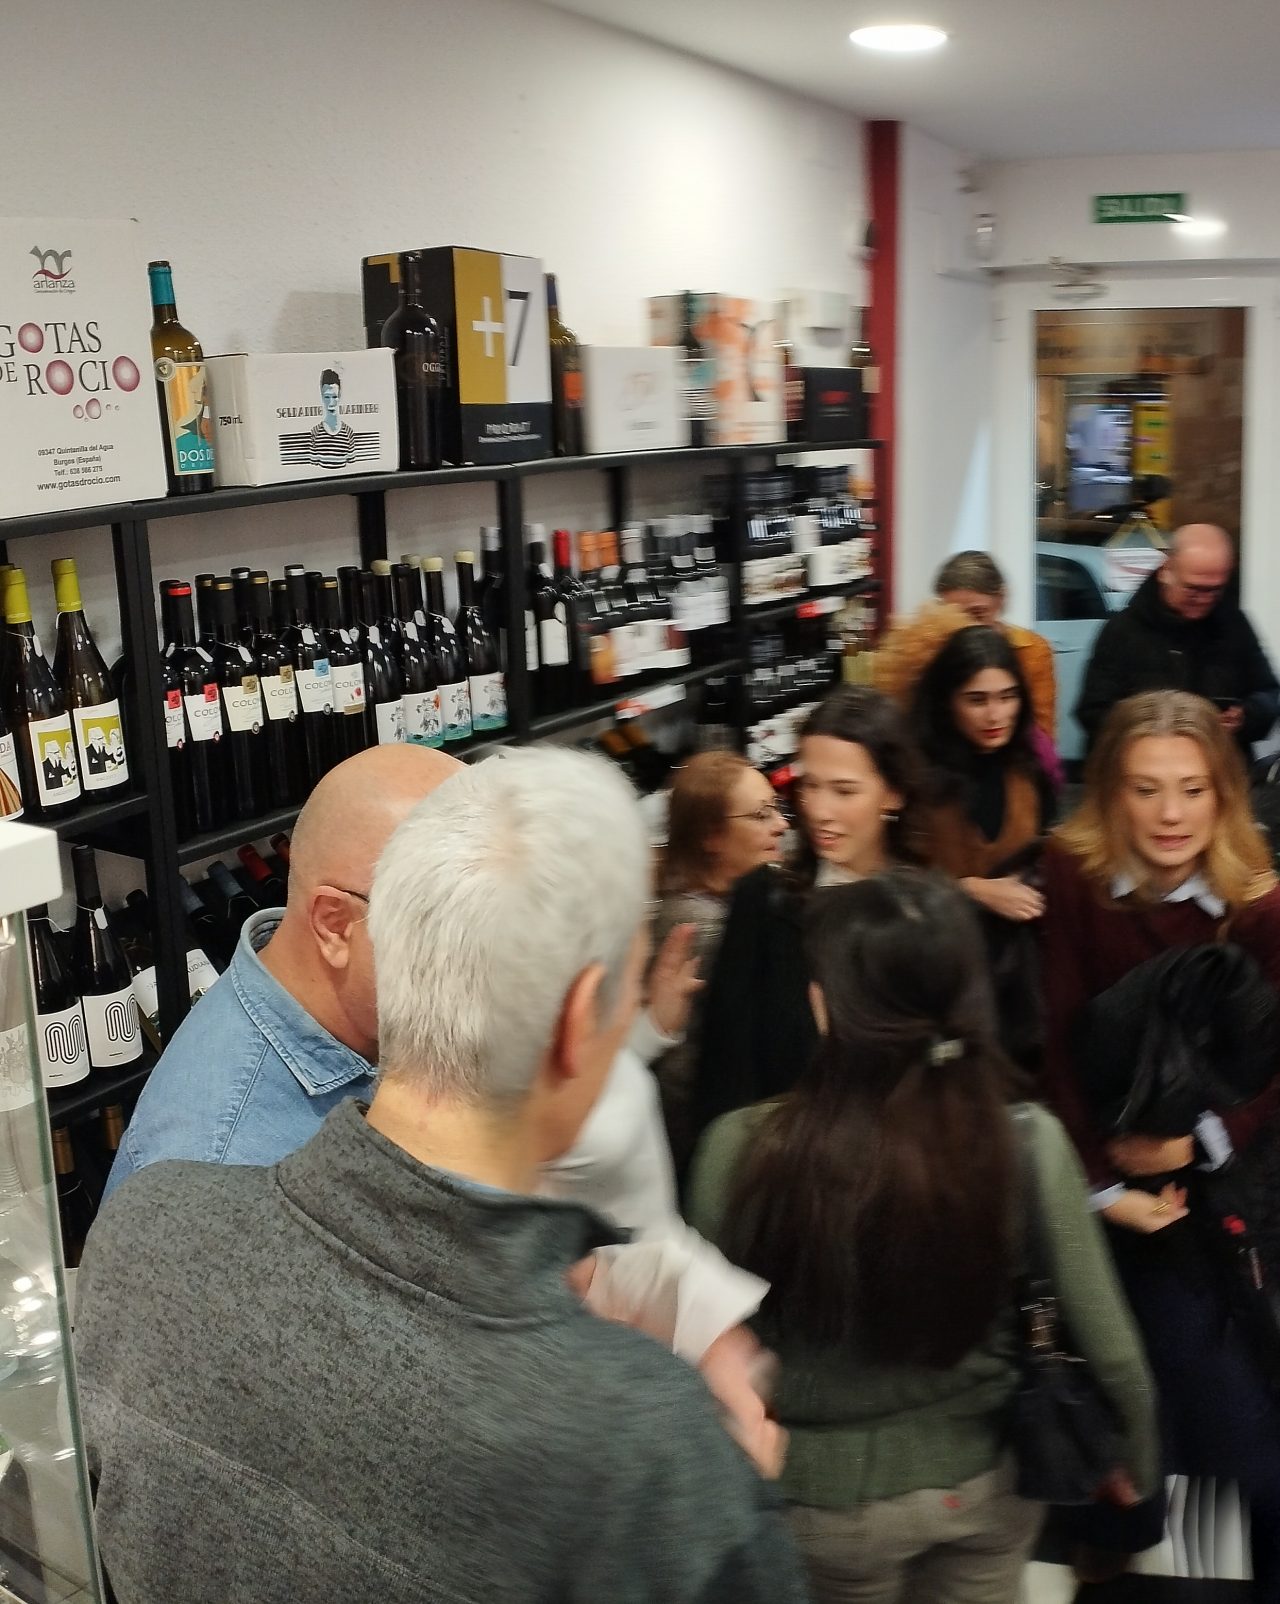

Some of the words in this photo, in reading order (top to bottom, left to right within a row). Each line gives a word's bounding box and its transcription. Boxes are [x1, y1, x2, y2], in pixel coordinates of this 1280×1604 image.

[33, 275, 75, 289] arlanza
[0, 321, 102, 358] GOTAS
[0, 361, 18, 383] E
[22, 355, 141, 396] ROCIO
[219, 416, 232, 426] 750
[98, 444, 114, 452] Agua
[53, 458, 75, 466] Burgos
[37, 475, 121, 491] www.gotasdrocio.com
